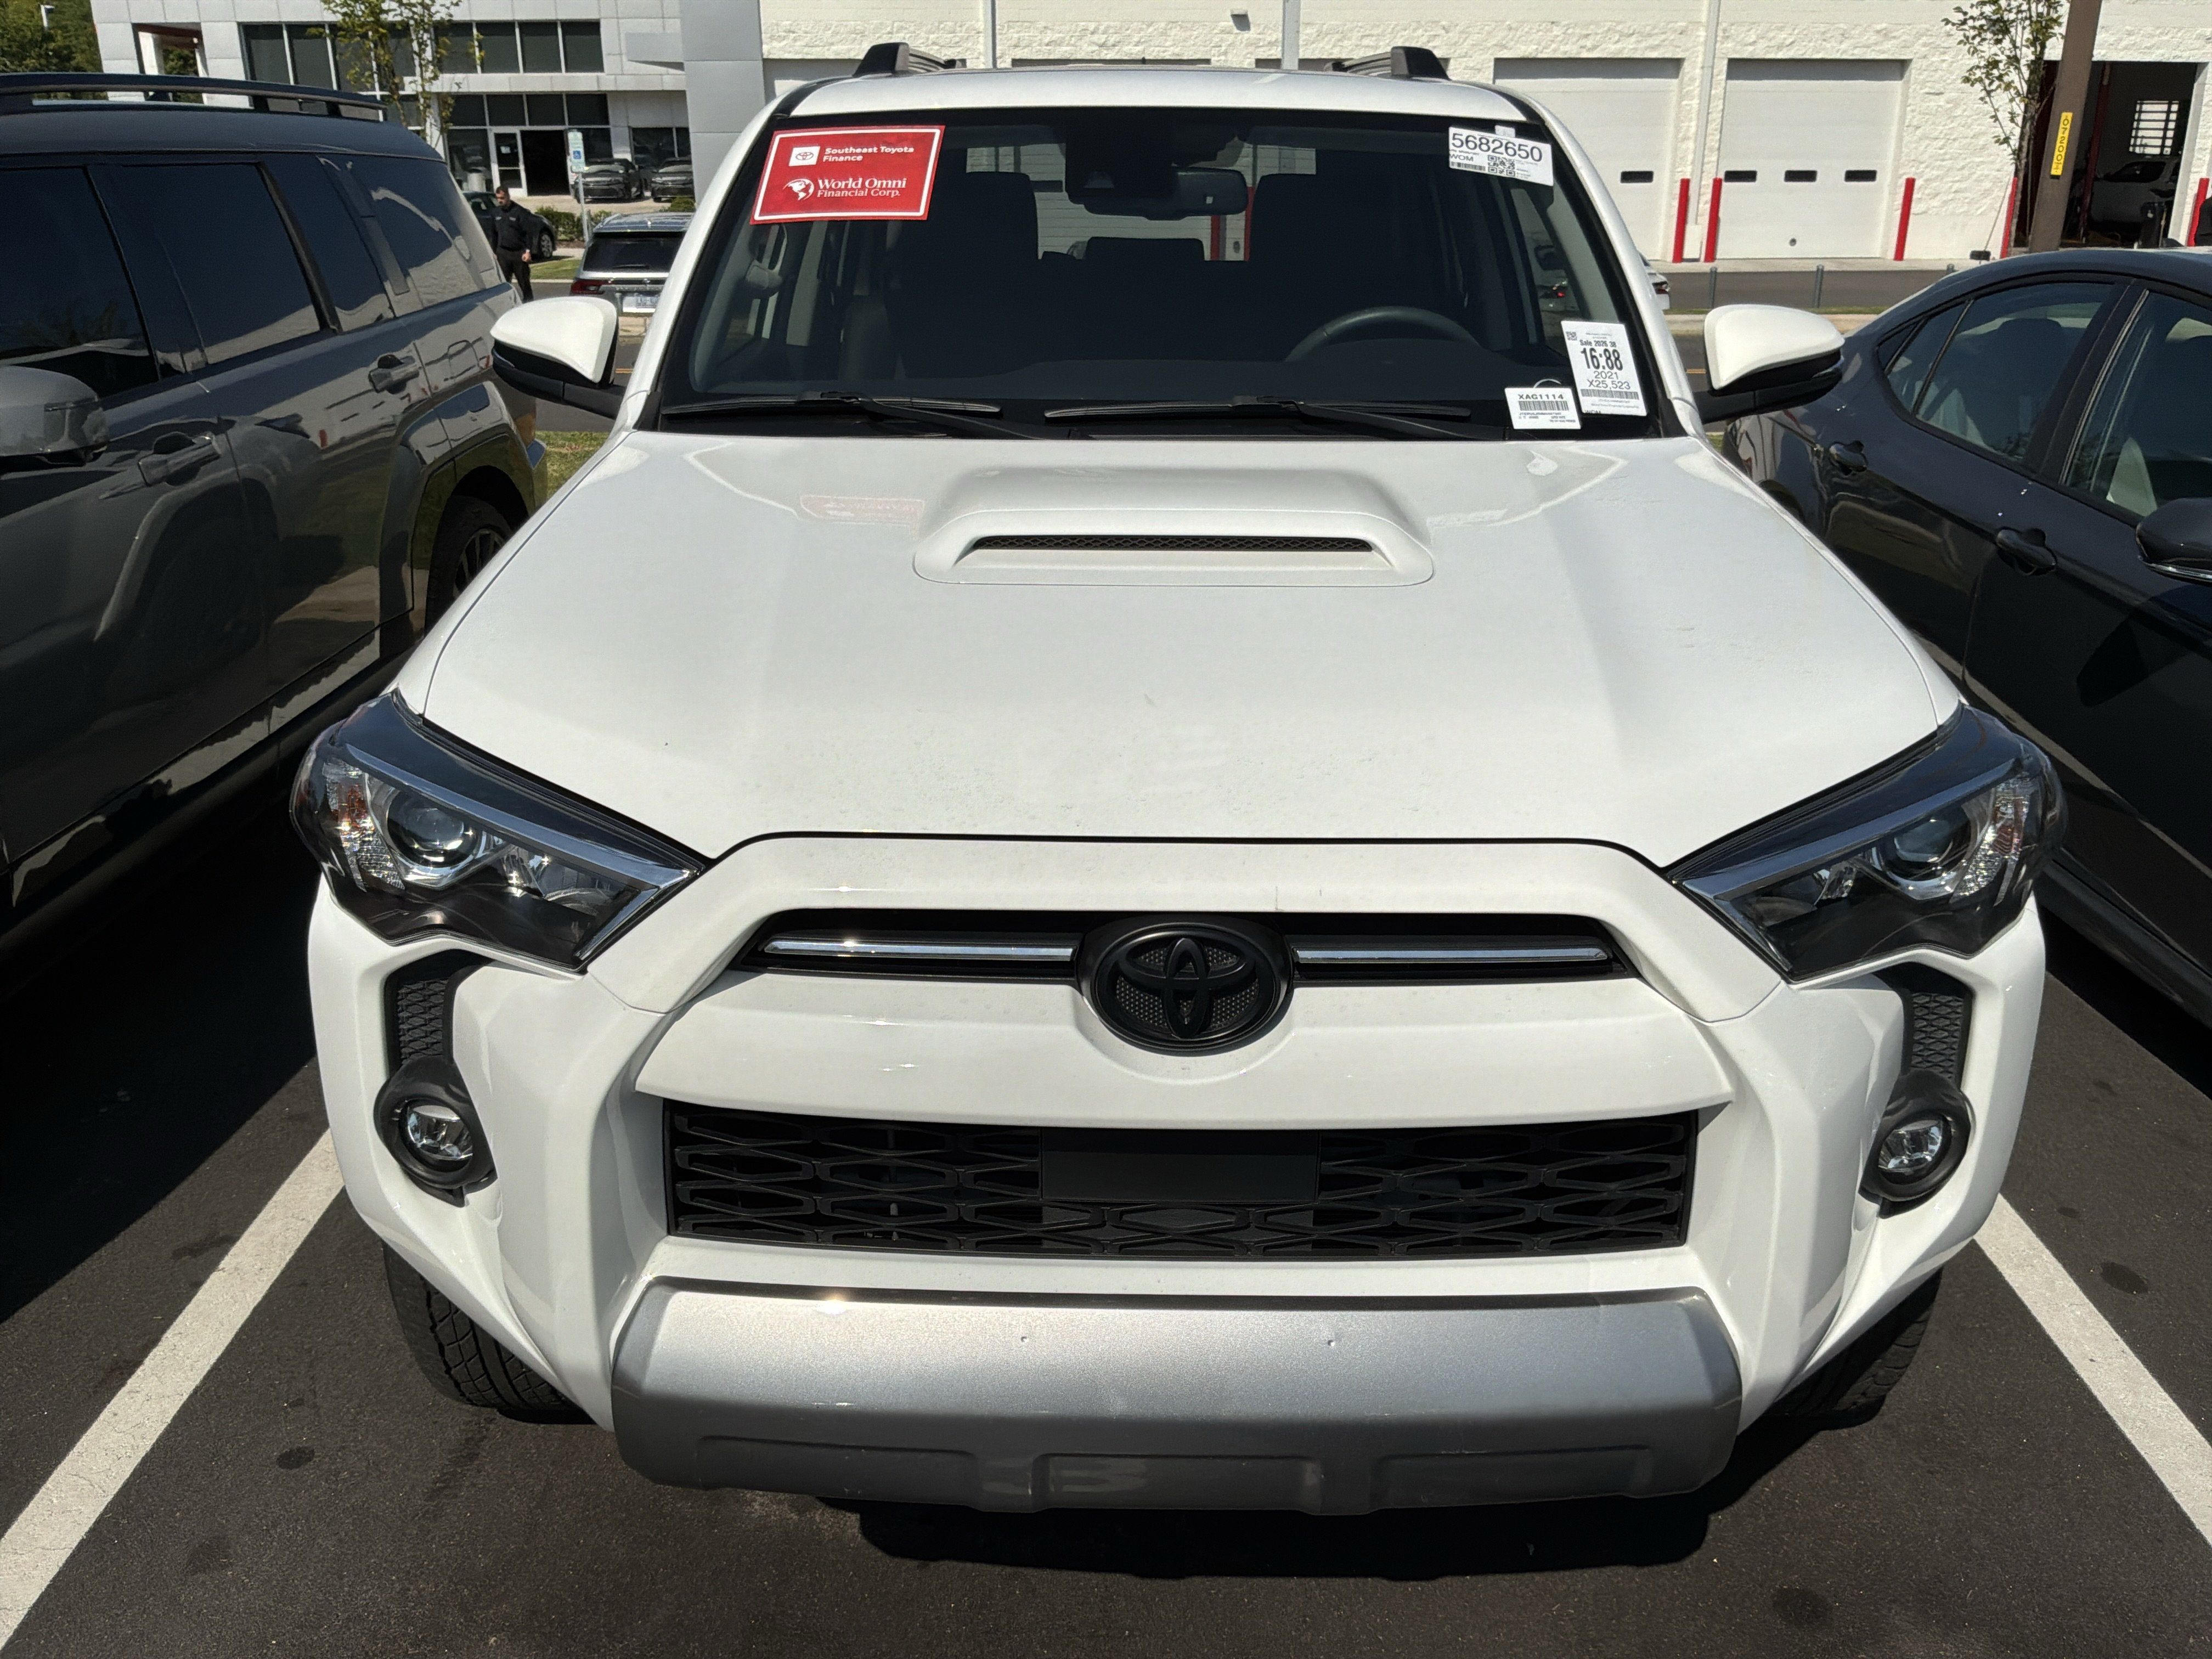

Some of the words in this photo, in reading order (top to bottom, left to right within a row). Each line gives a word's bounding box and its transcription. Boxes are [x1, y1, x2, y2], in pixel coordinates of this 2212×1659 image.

[824, 146, 878, 155] Southeast
[880, 146, 915, 154] Toyota
[1452, 133, 1543, 162] 5682650
[1449, 154, 1474, 162] WOM
[817, 177, 863, 189] World
[865, 177, 907, 189] Omni
[817, 188, 868, 198] Financial
[871, 188, 901, 198] Corp.
[1580, 347, 1623, 371] 16:88
[1593, 370, 1619, 380] 2021
[1587, 379, 1630, 391] X25,523
